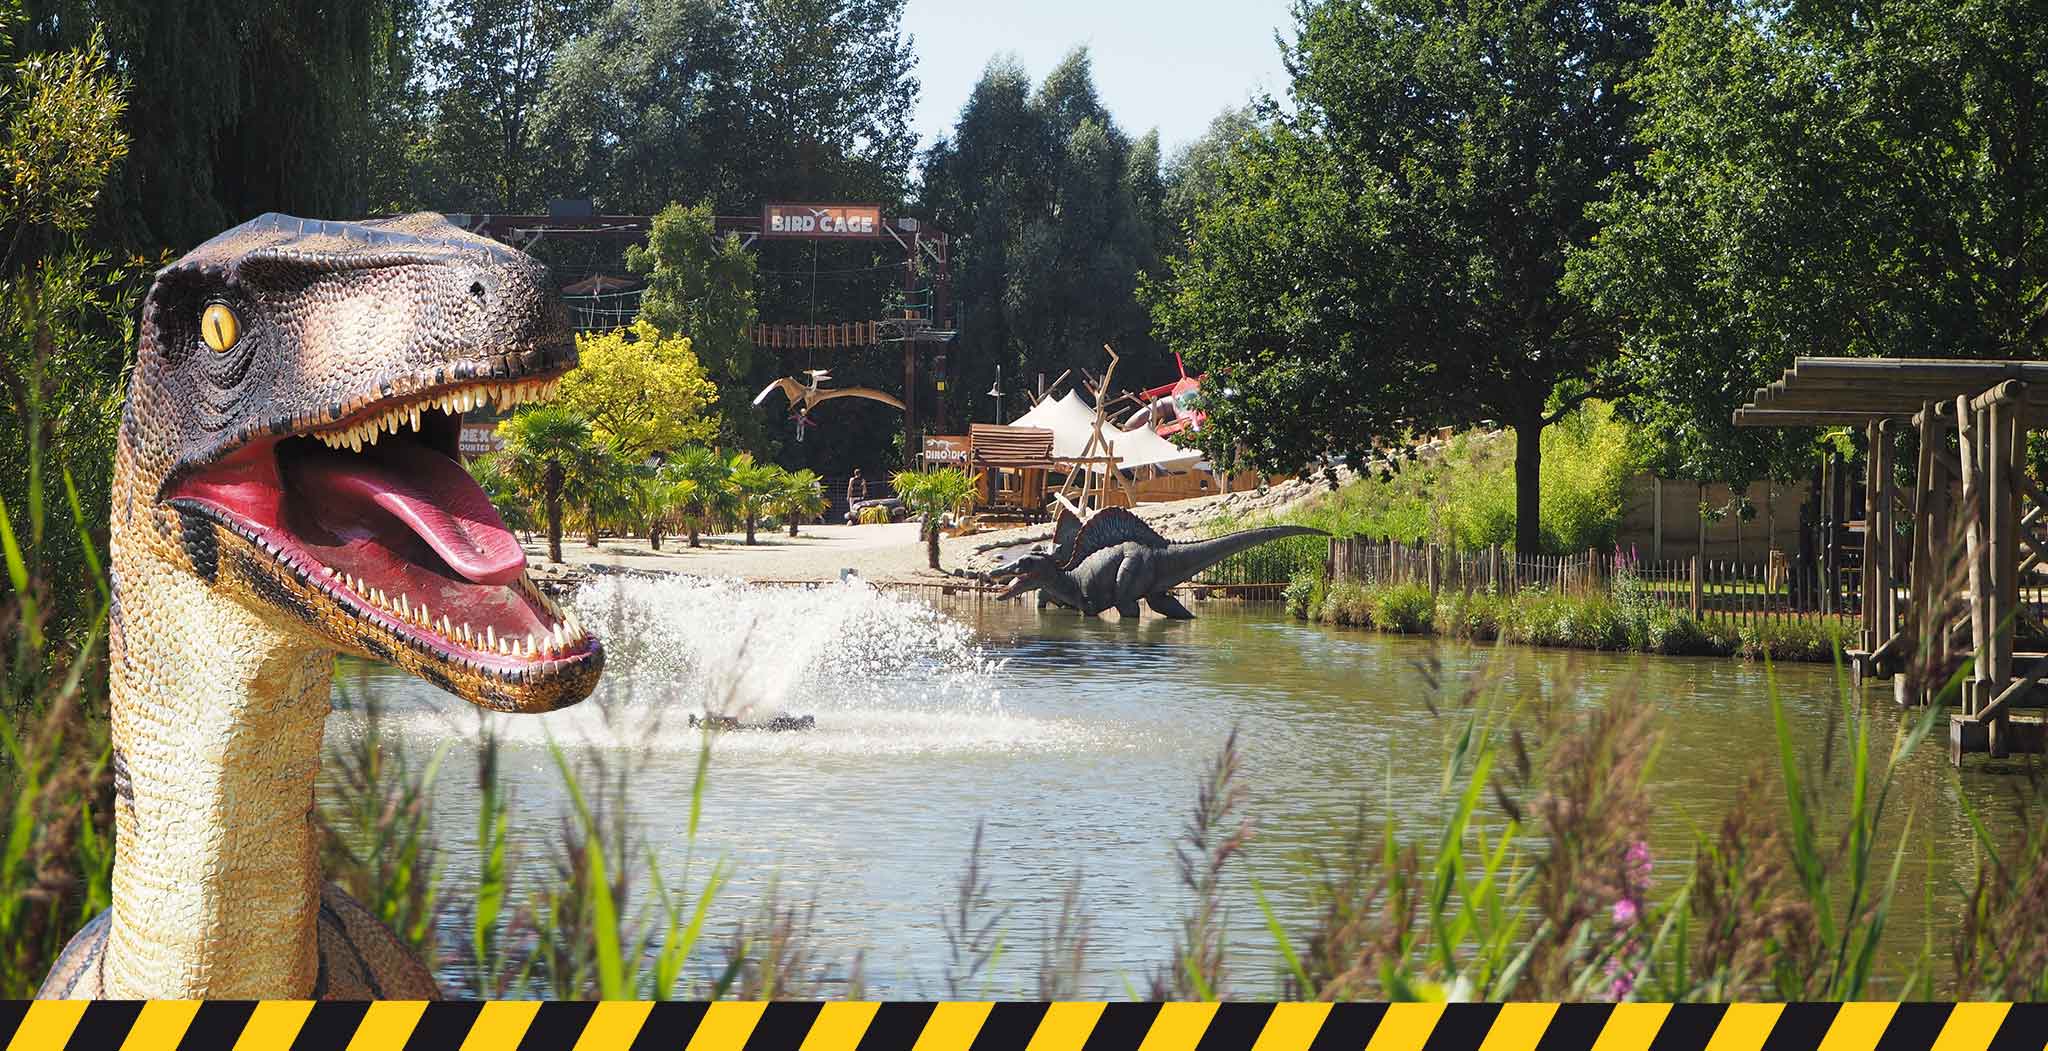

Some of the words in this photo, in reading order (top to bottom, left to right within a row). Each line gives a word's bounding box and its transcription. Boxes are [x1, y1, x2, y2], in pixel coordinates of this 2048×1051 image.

[771, 215, 816, 233] BIRD
[820, 216, 873, 233] CAGE
[460, 429, 489, 442] REX
[926, 450, 947, 460] DINO
[951, 450, 967, 460] DIG
